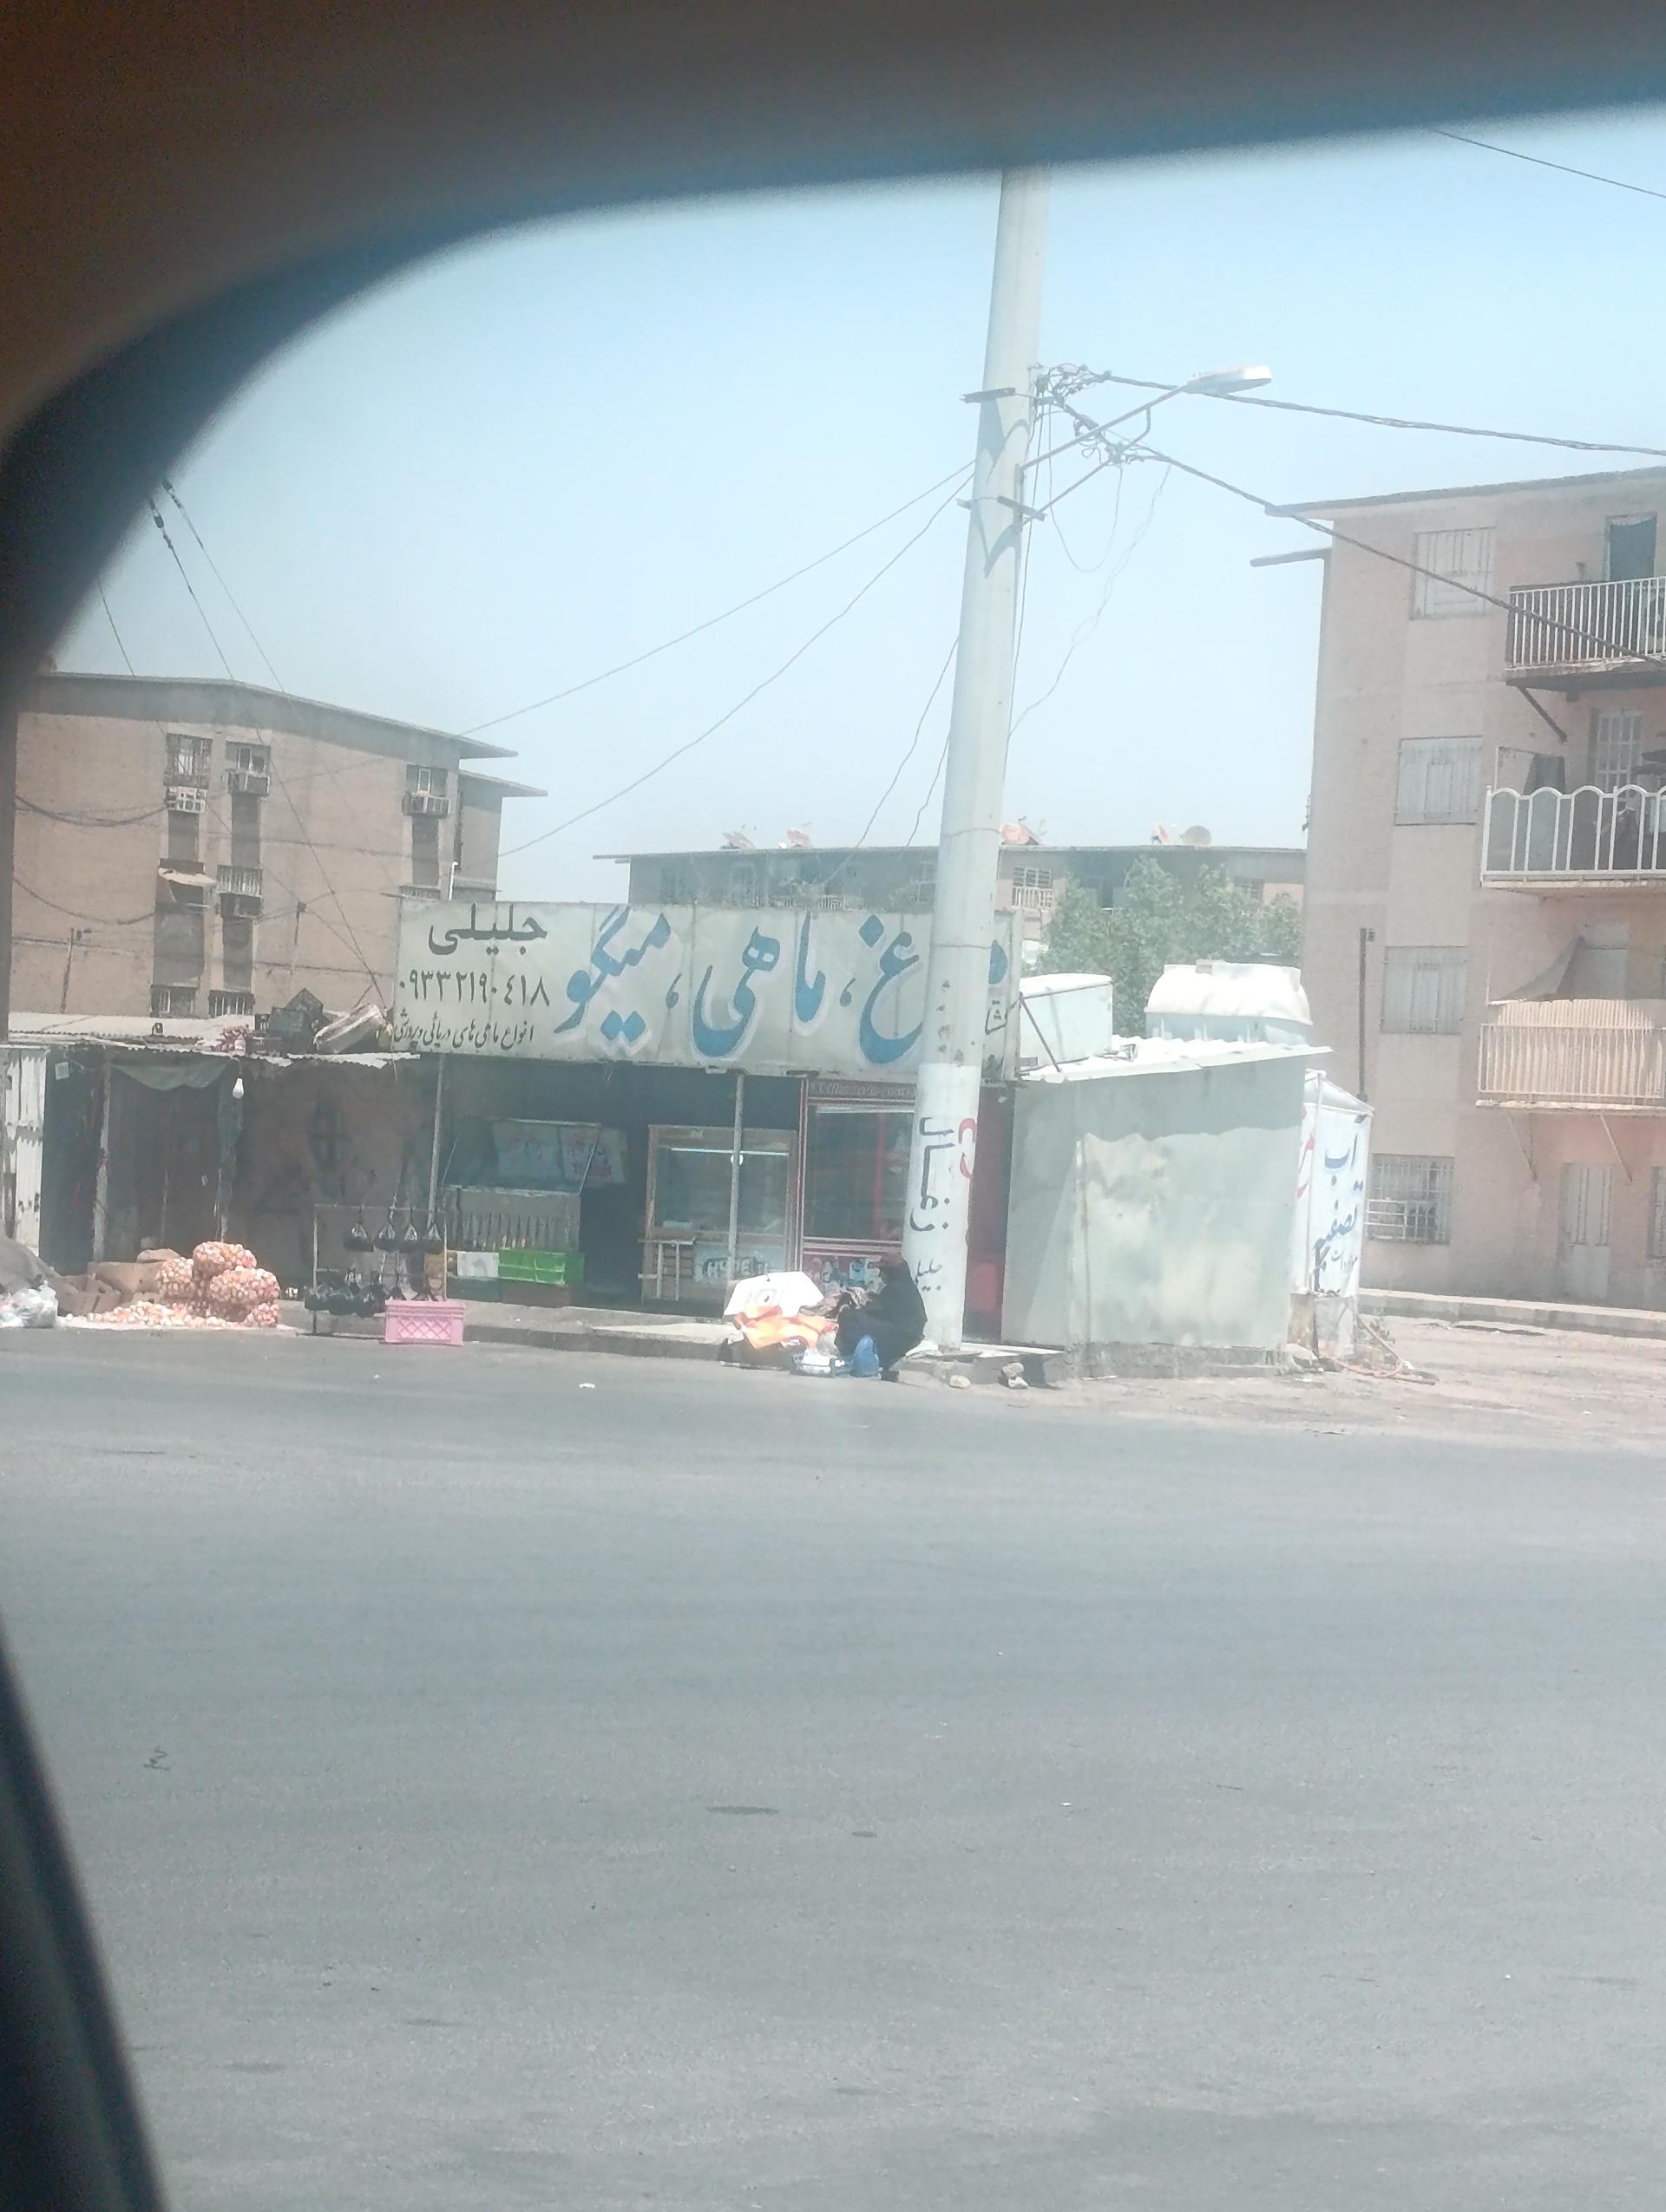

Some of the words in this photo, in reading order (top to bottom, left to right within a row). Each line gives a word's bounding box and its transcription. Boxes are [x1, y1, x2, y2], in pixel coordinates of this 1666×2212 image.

[428, 902, 548, 956] جلیلی
[554, 906, 672, 1044] میگو
[474, 1020, 499, 1048] ماهی
[500, 1020, 535, 1050] انواع
